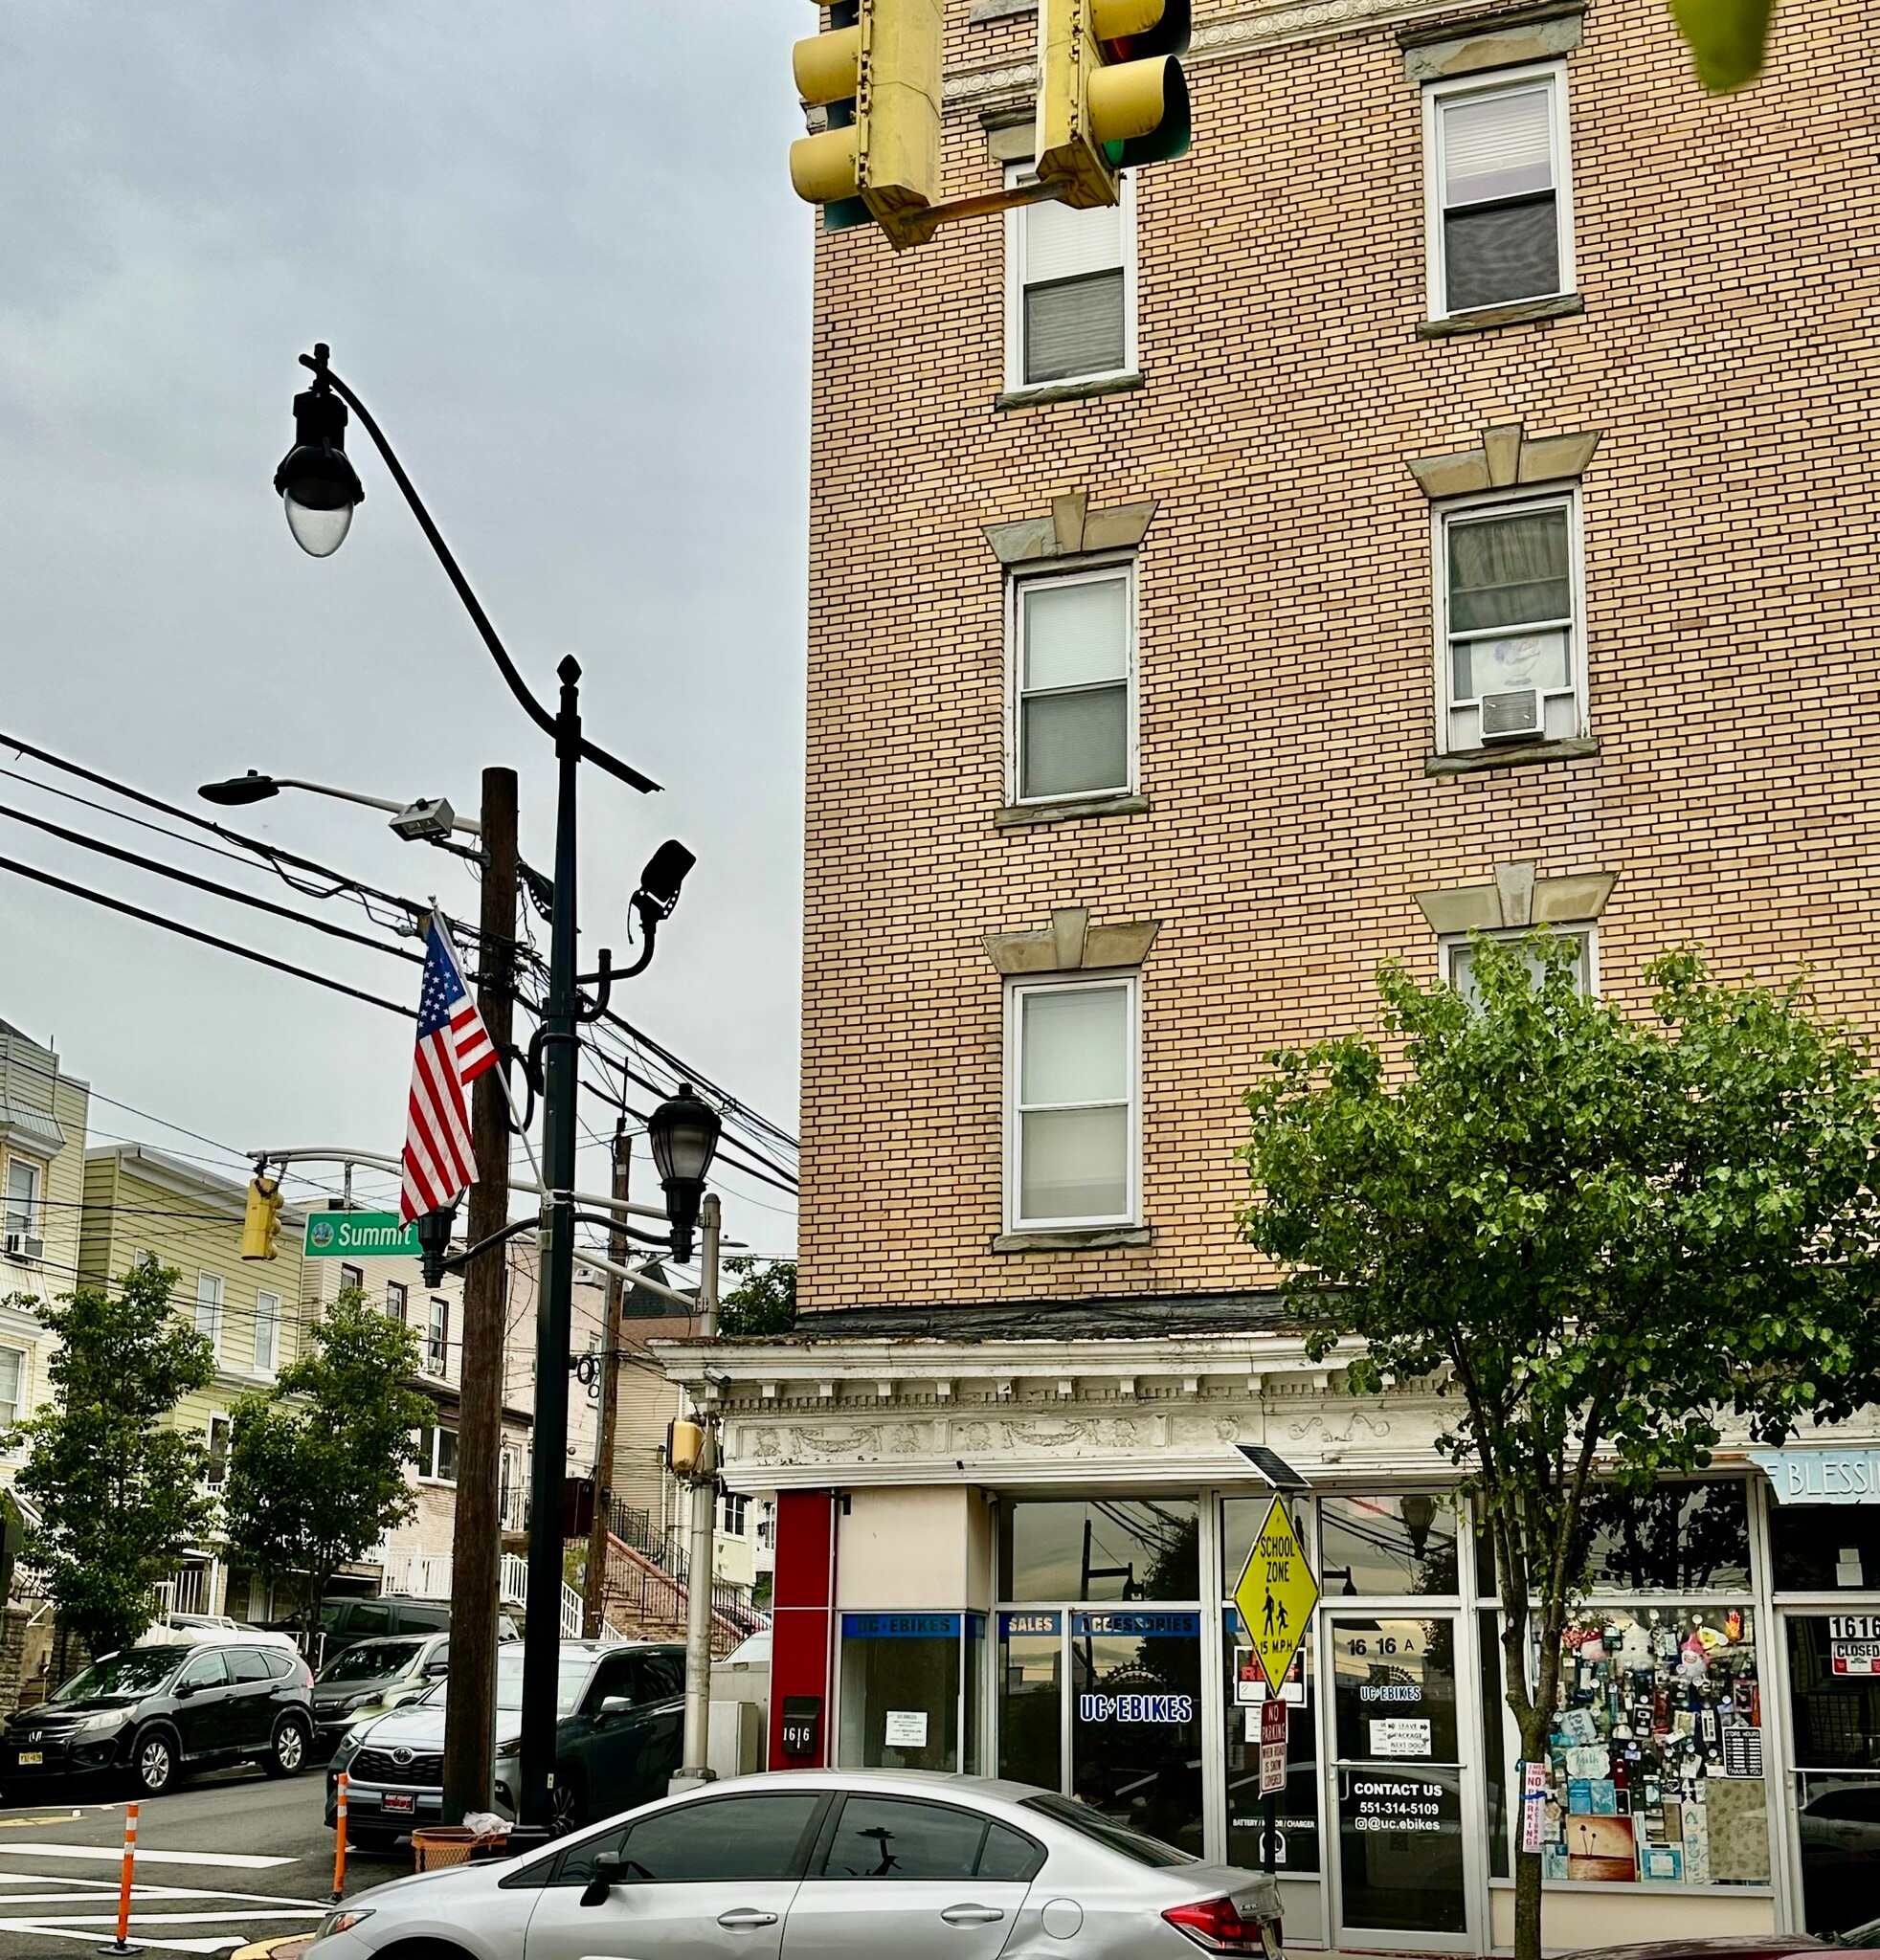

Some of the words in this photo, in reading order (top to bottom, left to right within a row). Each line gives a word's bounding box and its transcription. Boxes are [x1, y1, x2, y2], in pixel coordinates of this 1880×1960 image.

[338, 1222, 413, 1246] Summit
[1260, 1536, 1295, 1557] SCHOOL
[1265, 1561, 1289, 1583] ZONE
[890, 1617, 951, 1633] EBIKES
[1008, 1616, 1053, 1632] SALES
[1081, 1616, 1194, 1633] ACCESSORIES
[1832, 1616, 1880, 1637] 1616
[1260, 1640, 1268, 1655] 15
[1404, 1638, 1415, 1651] A
[1837, 1644, 1880, 1657] CLOSED
[1241, 1666, 1300, 1682] RET
[1379, 1685, 1421, 1702] EBIKES
[1080, 1694, 1108, 1722] UC
[1117, 1695, 1193, 1723] EBIKES
[1268, 1704, 1279, 1722] NO
[1262, 1723, 1286, 1742] PARKING
[1354, 1782, 1420, 1795] CONTACT
[1423, 1784, 1444, 1796] US
[1528, 1776, 1541, 1787] NO
[1359, 1801, 1440, 1815] 551-314-5109
[1232, 1818, 1258, 1827] BATTERY
[1287, 1819, 1315, 1828] CHARGER
[1368, 1816, 1441, 1831] @uc.ebikes
